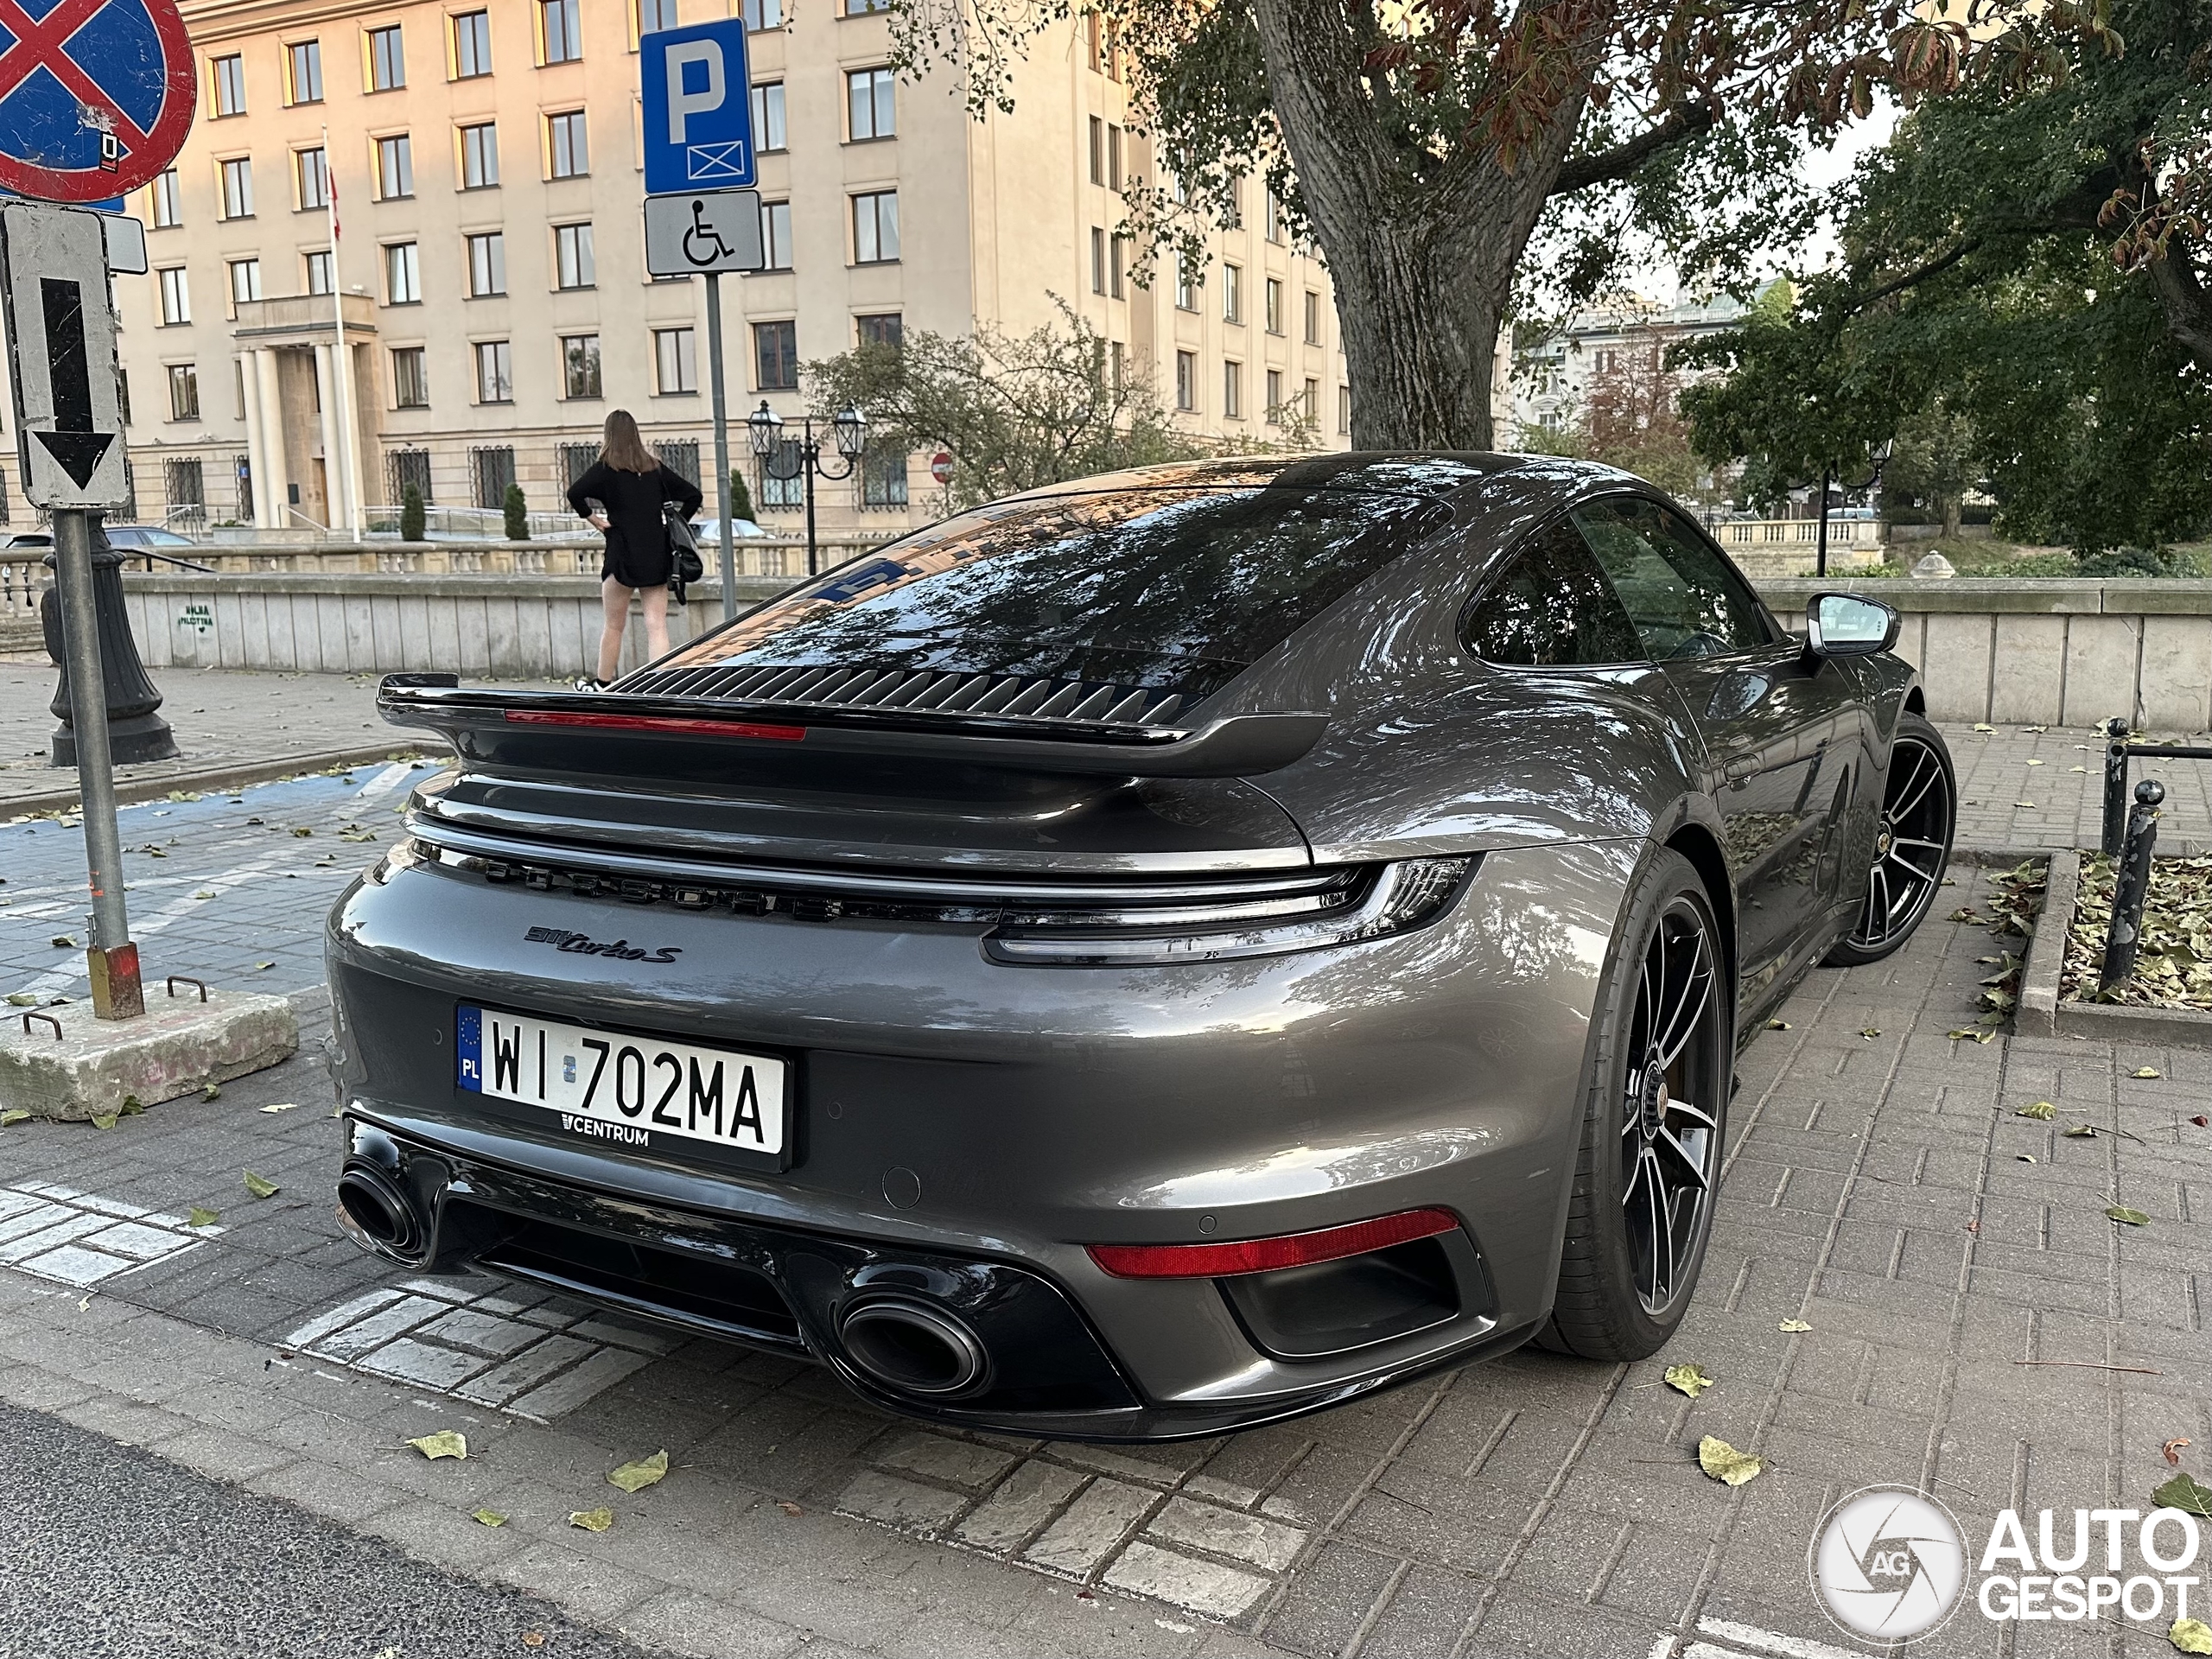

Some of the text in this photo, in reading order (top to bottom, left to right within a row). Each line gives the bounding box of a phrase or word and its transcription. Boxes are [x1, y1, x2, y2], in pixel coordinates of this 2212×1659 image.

[665, 38, 726, 144] P
[462, 1058, 480, 1079] PL
[493, 1020, 765, 1144] WI 702MA
